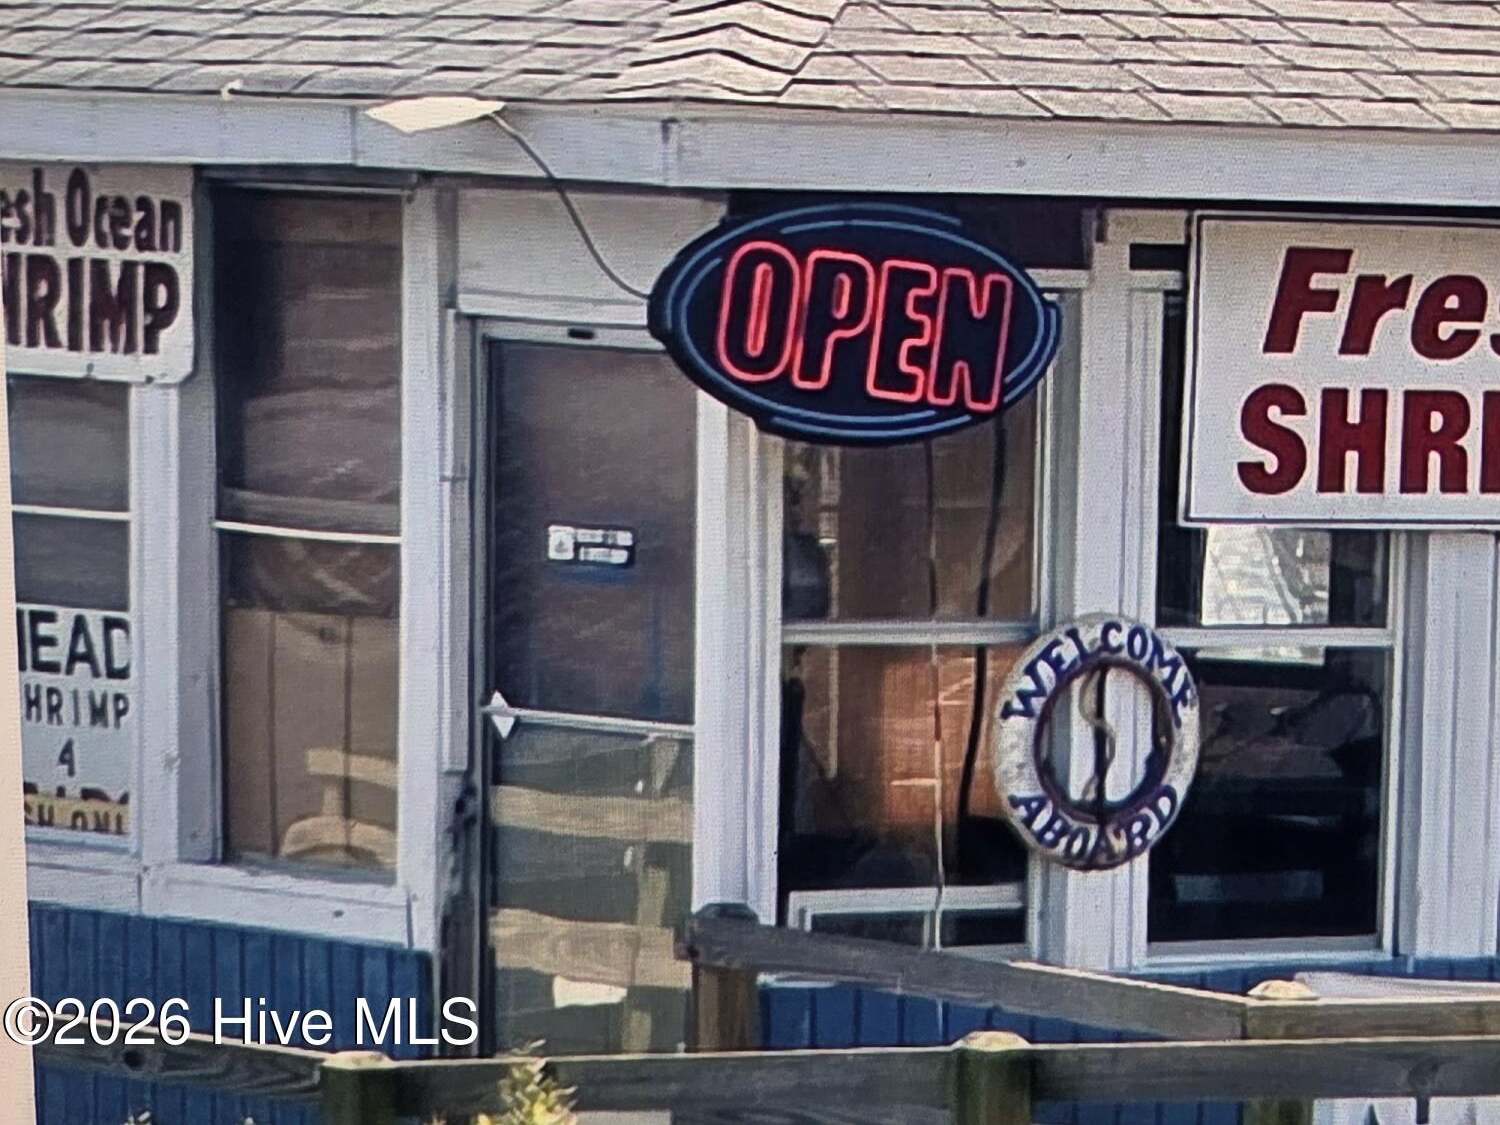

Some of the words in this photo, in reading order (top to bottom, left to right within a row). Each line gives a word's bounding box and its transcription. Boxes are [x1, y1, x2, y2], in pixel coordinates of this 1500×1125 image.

[67, 167, 183, 253] Ocean
[716, 240, 1013, 413] OPEN
[24, 683, 129, 730] HRIMP
[1000, 621, 1195, 729] WELCOME
